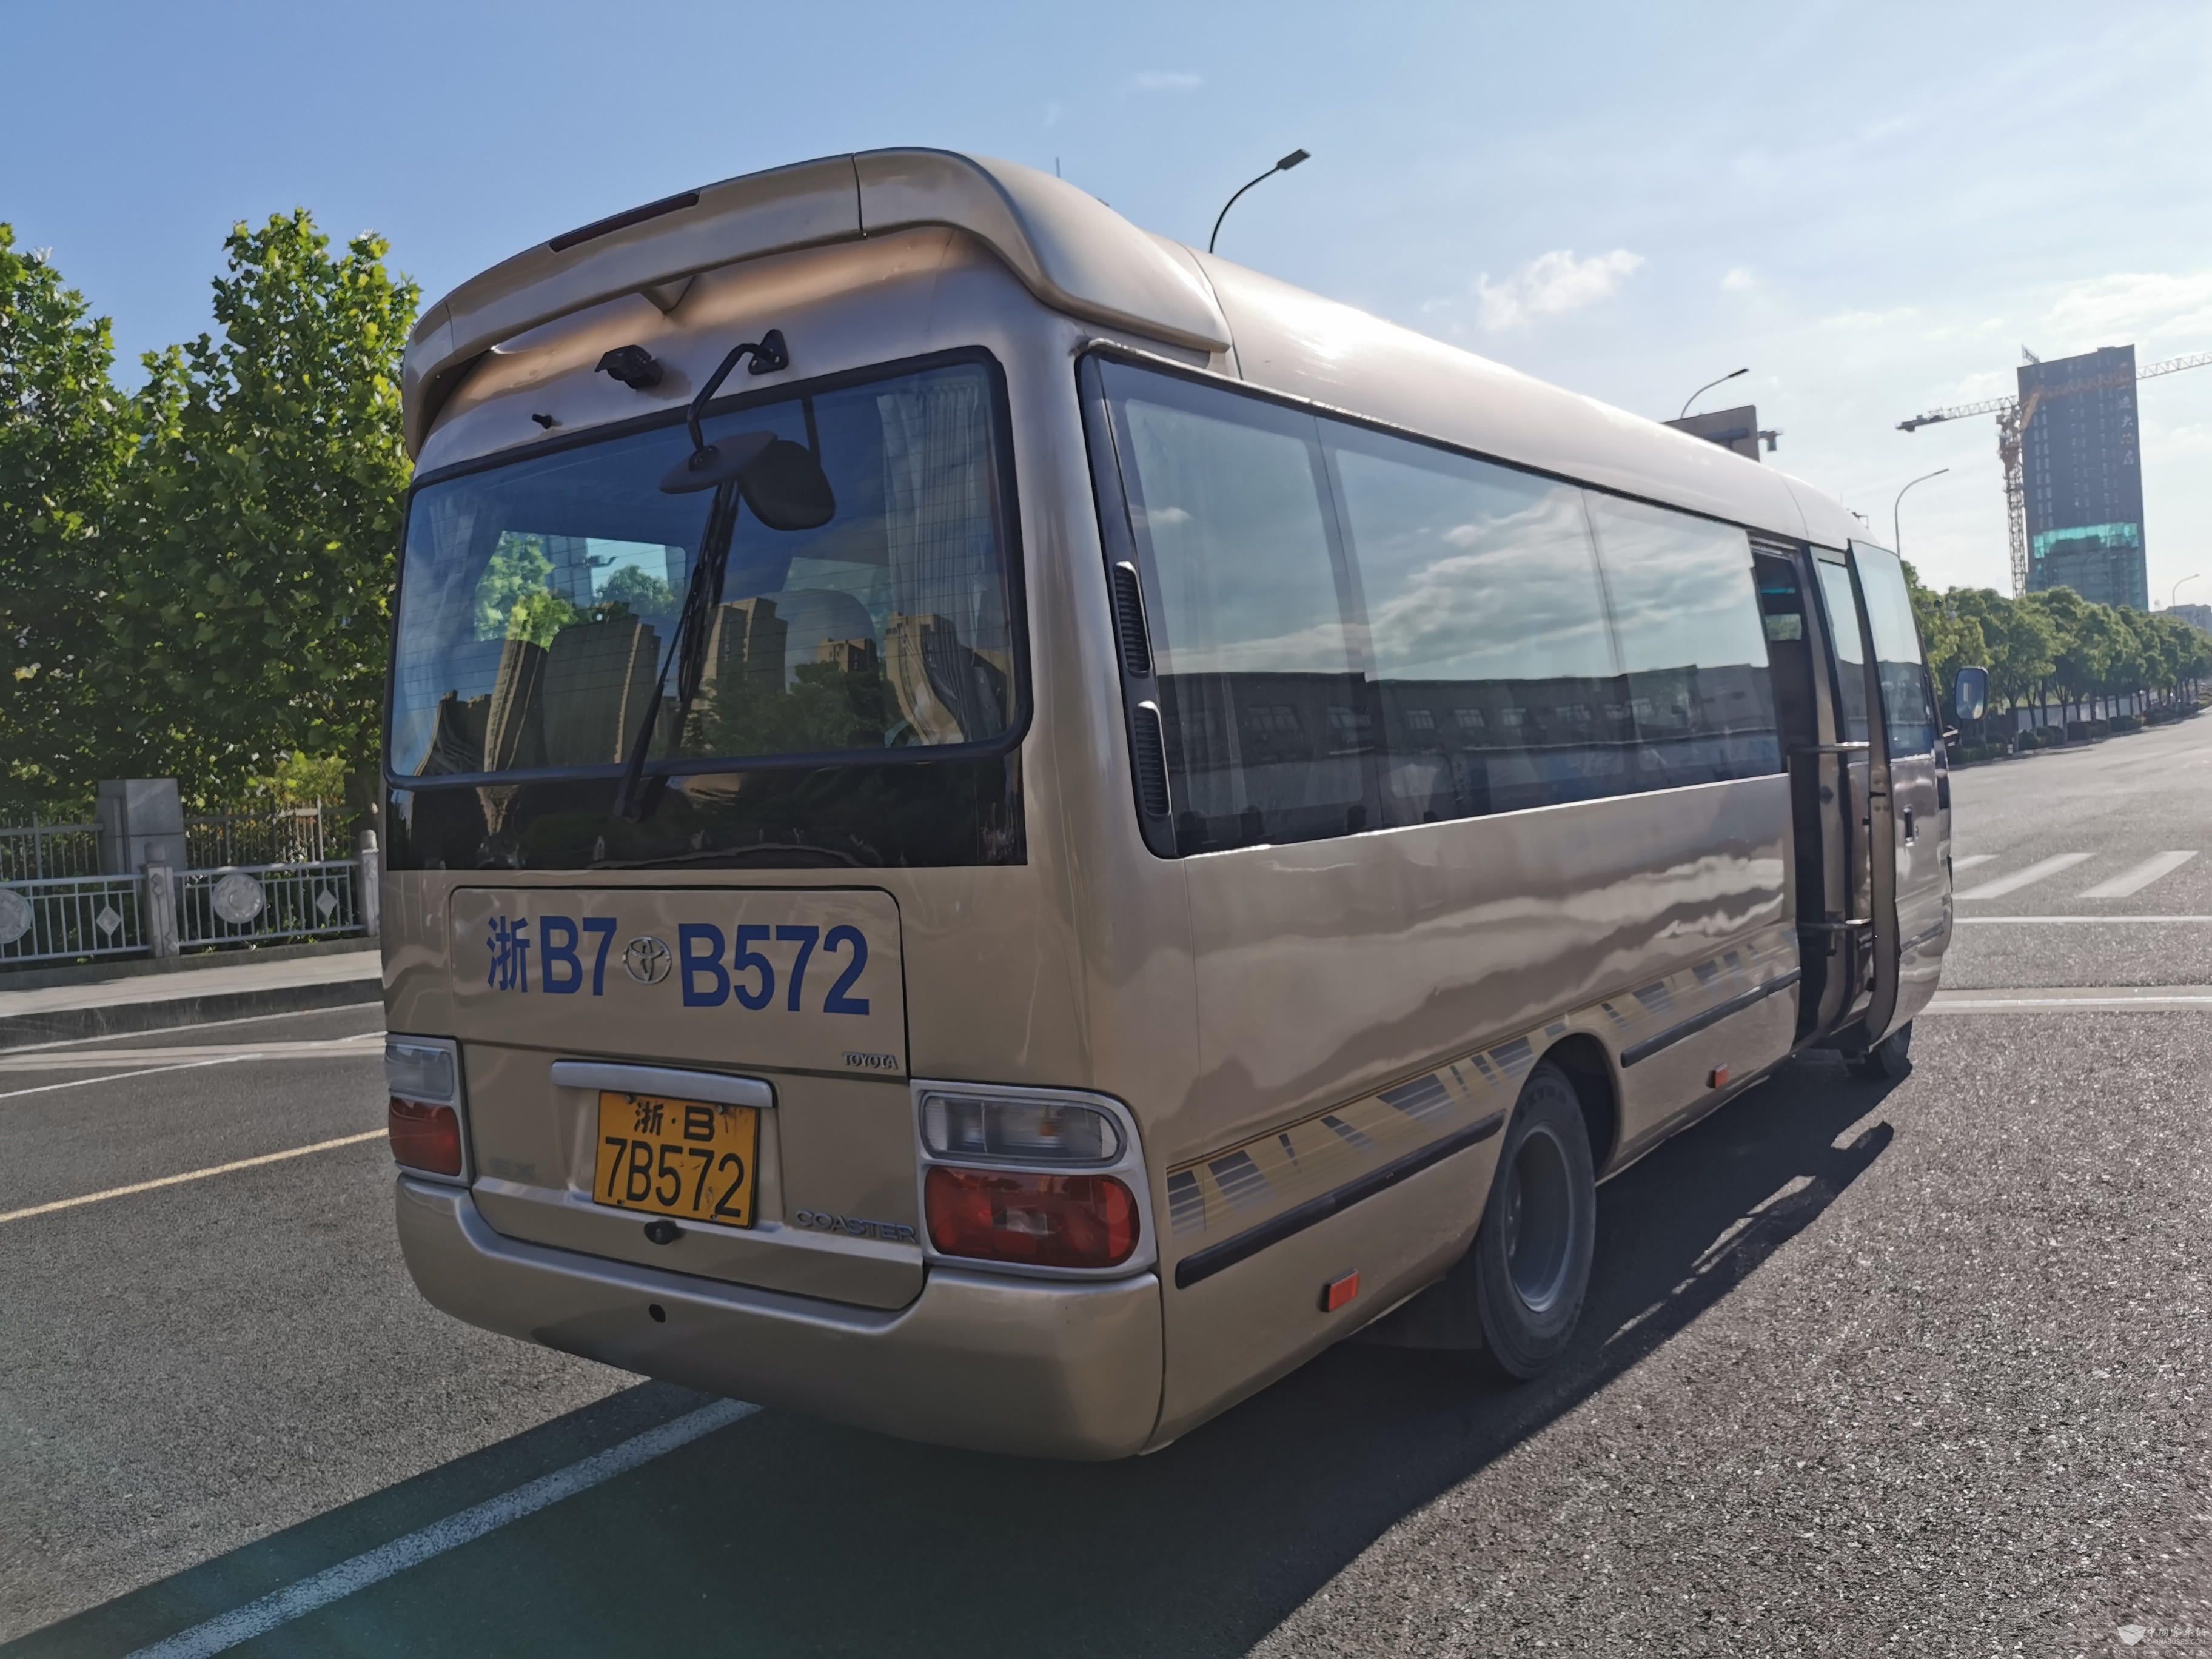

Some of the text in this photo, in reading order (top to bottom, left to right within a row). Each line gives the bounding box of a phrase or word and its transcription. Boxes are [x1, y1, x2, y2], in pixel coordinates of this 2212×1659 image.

[678, 923, 870, 1015] B572
[842, 1052, 899, 1069] TOYOTA
[605, 1136, 745, 1219] 7B572
[796, 1209, 918, 1243] COASTER
